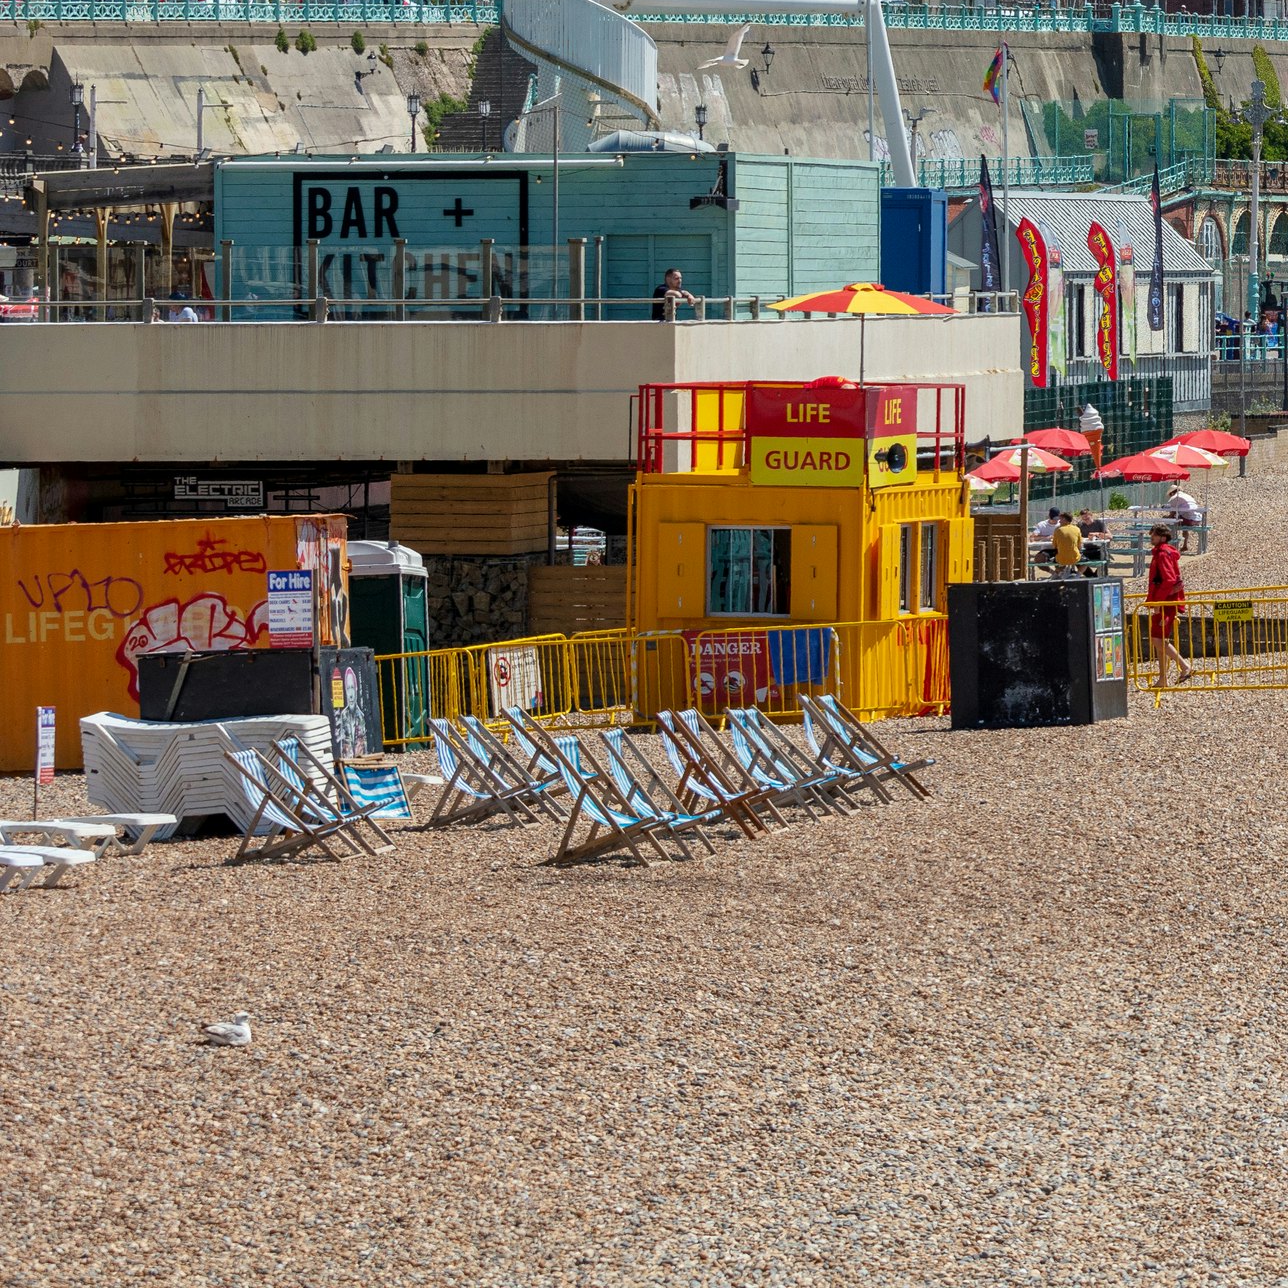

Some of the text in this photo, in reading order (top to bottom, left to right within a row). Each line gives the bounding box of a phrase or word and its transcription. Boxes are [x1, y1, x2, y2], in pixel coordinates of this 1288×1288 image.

[308, 187, 474, 238] BAR +
[310, 253, 513, 300] KITCHEN
[787, 403, 831, 423] LIFE
[884, 398, 902, 425] LIFE
[765, 450, 851, 471] GUARD
[174, 477, 197, 485] THE
[174, 485, 260, 496] ELECTRIC
[228, 496, 262, 506] ARCADE
[270, 572, 311, 590] For Hire
[691, 642, 763, 656] DANGER
